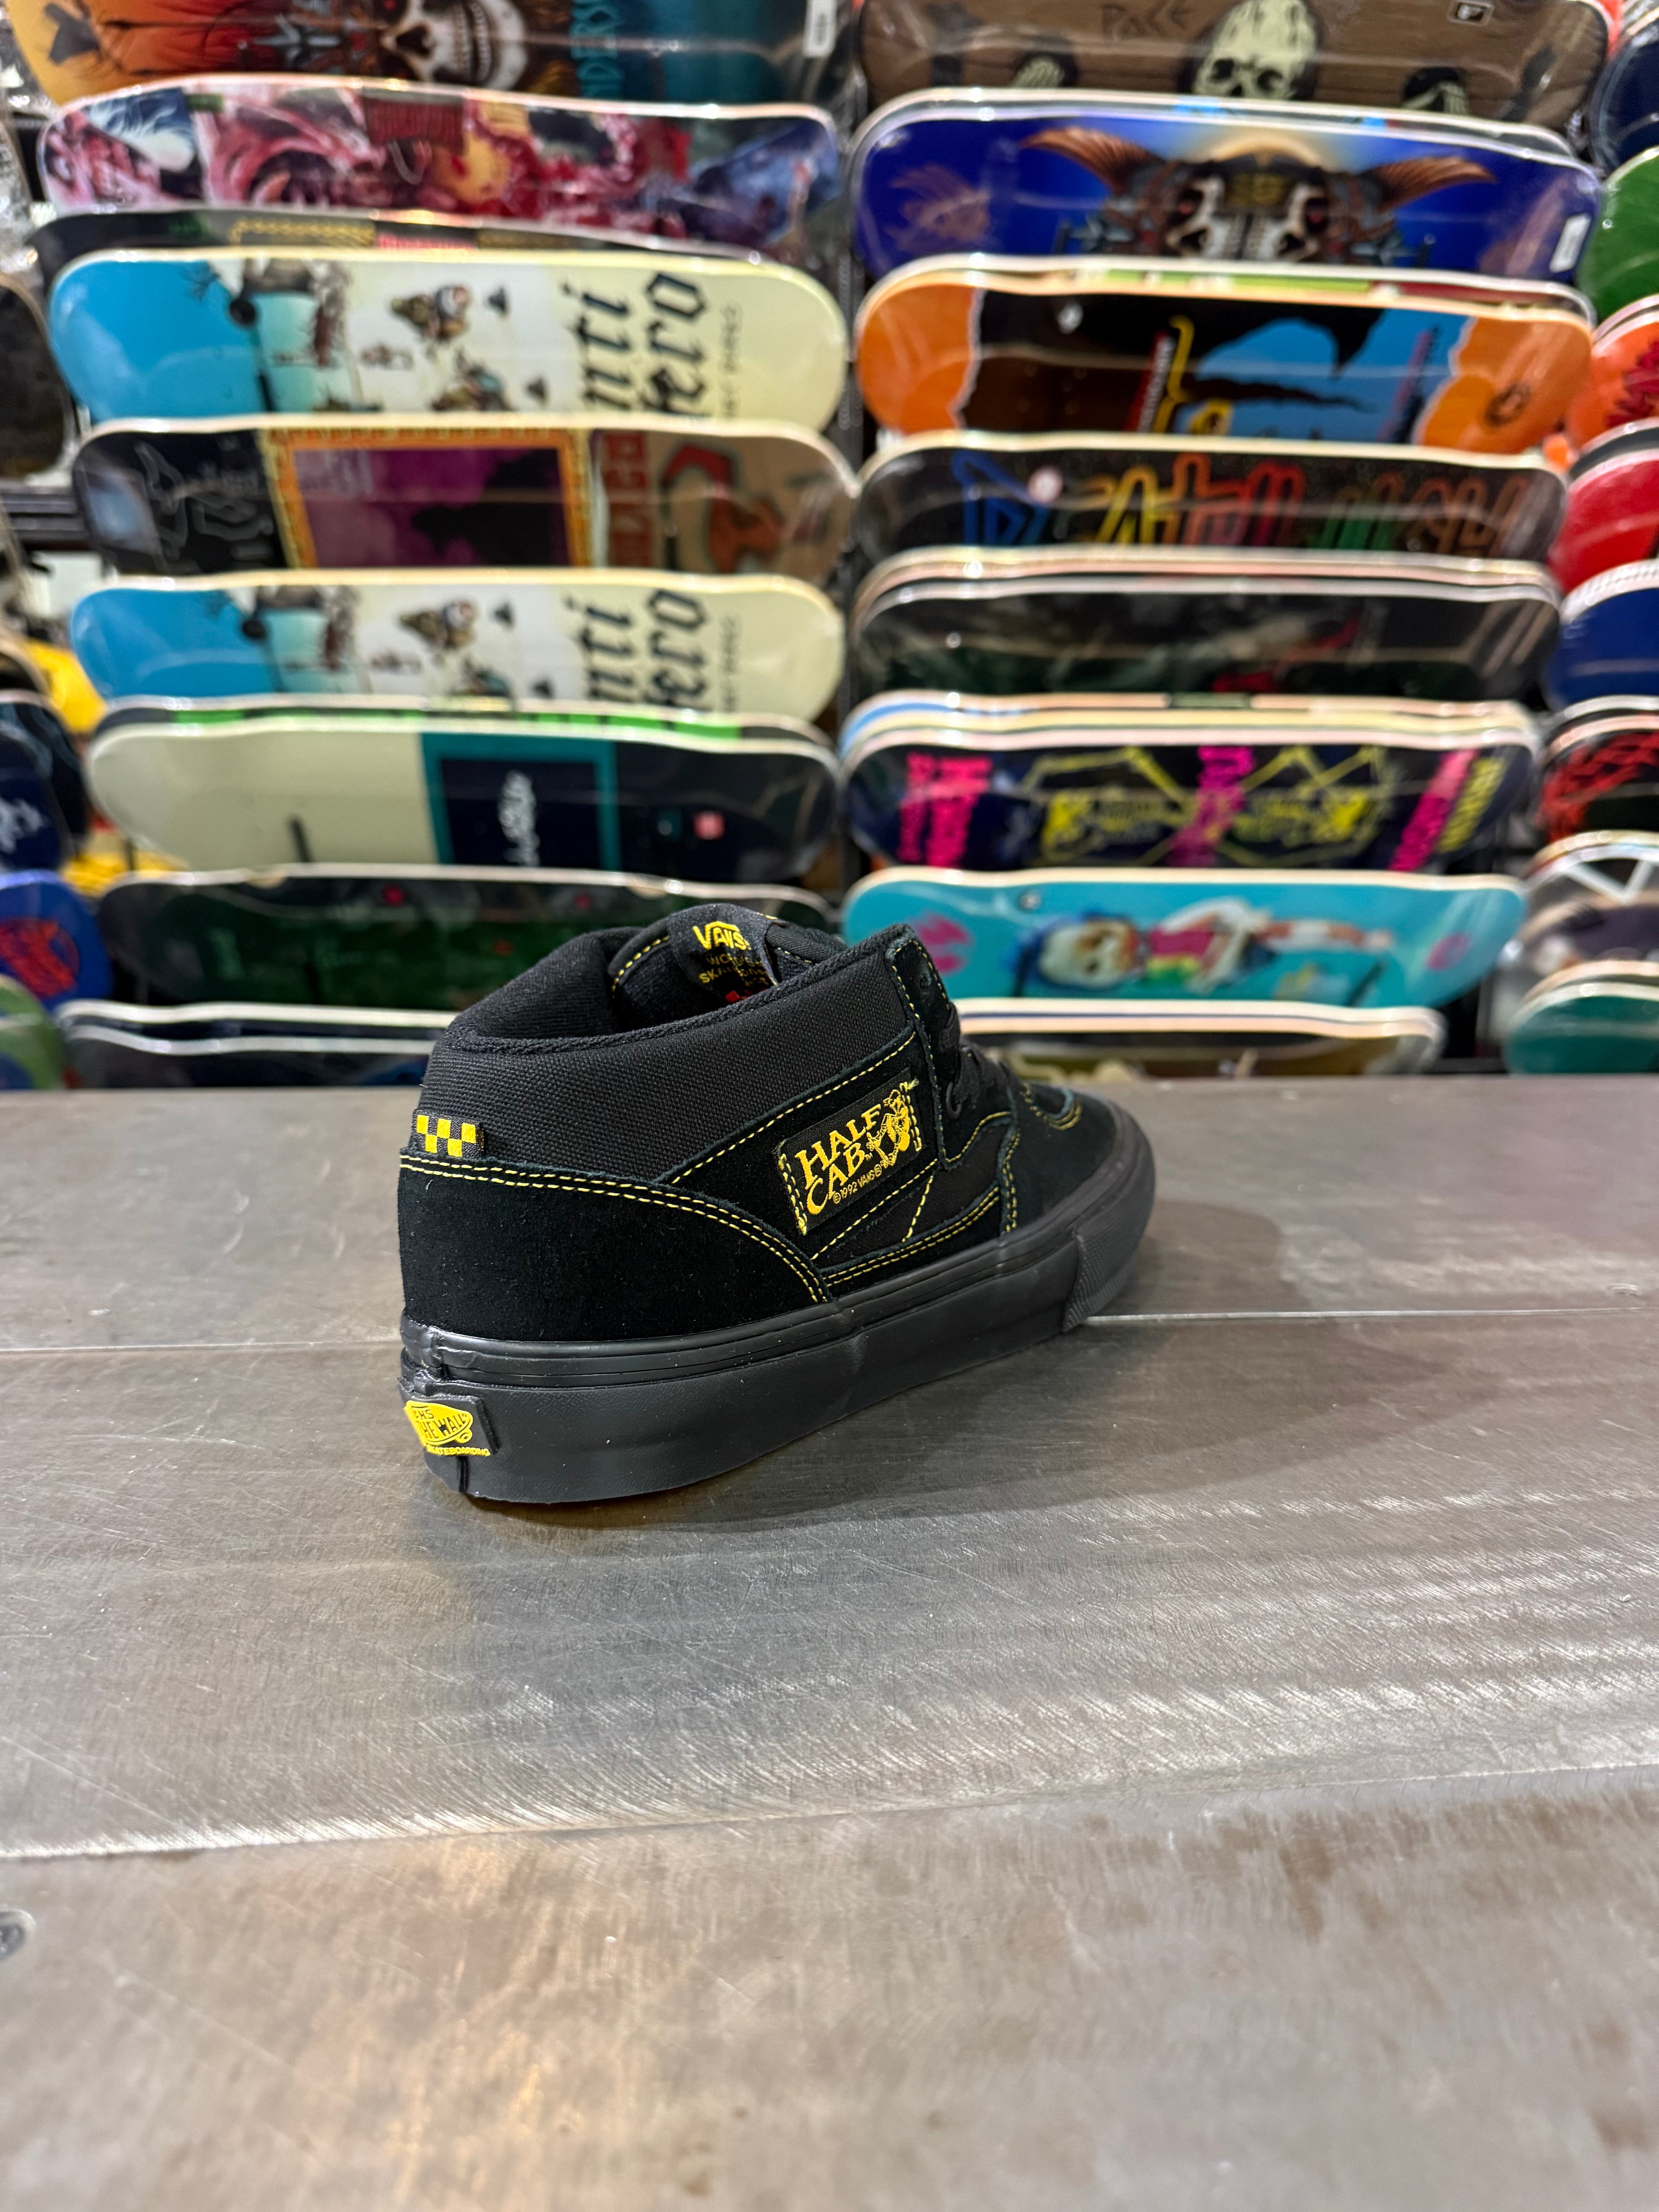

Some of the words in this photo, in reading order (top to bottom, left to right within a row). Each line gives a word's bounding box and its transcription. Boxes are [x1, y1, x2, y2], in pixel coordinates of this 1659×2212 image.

[559, 280, 632, 410] nti
[564, 594, 634, 703] nti
[693, 921, 747, 950] VANS
[795, 1103, 881, 1190] HALF
[833, 1182, 858, 1205] ©1992
